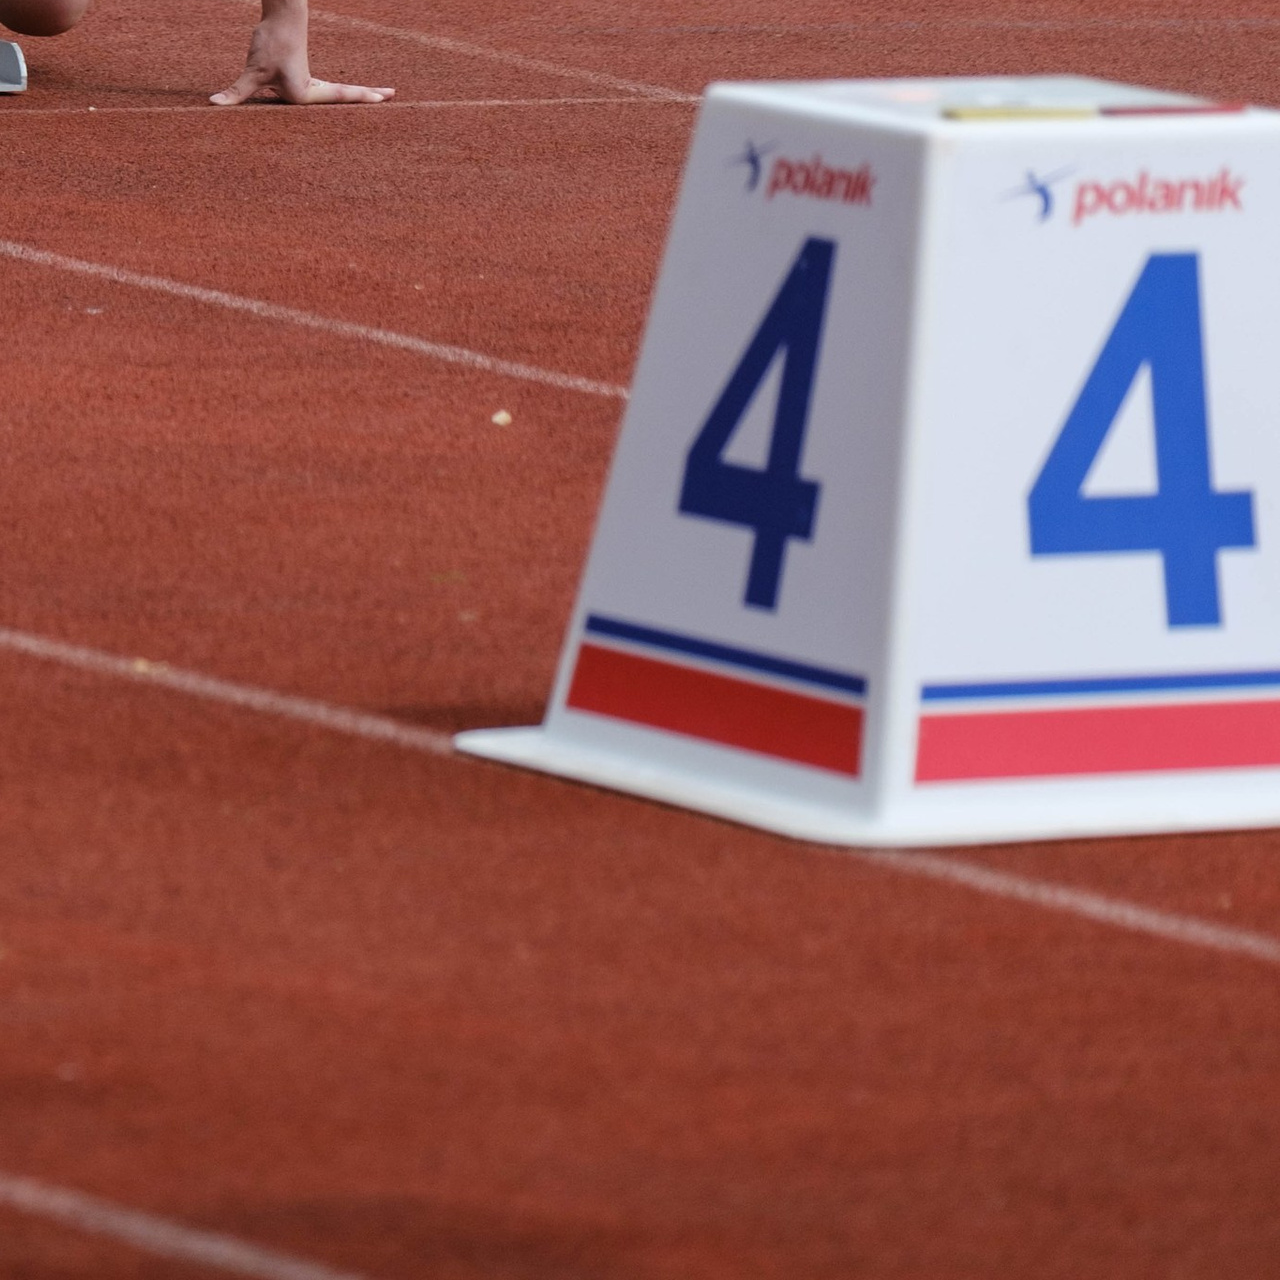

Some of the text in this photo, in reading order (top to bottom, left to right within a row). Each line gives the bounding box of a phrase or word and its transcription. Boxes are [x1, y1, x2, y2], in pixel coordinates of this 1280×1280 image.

[765, 150, 876, 208] polanik
[1070, 165, 1246, 227] polanik
[678, 235, 837, 613] 4
[1028, 251, 1257, 629] 4
